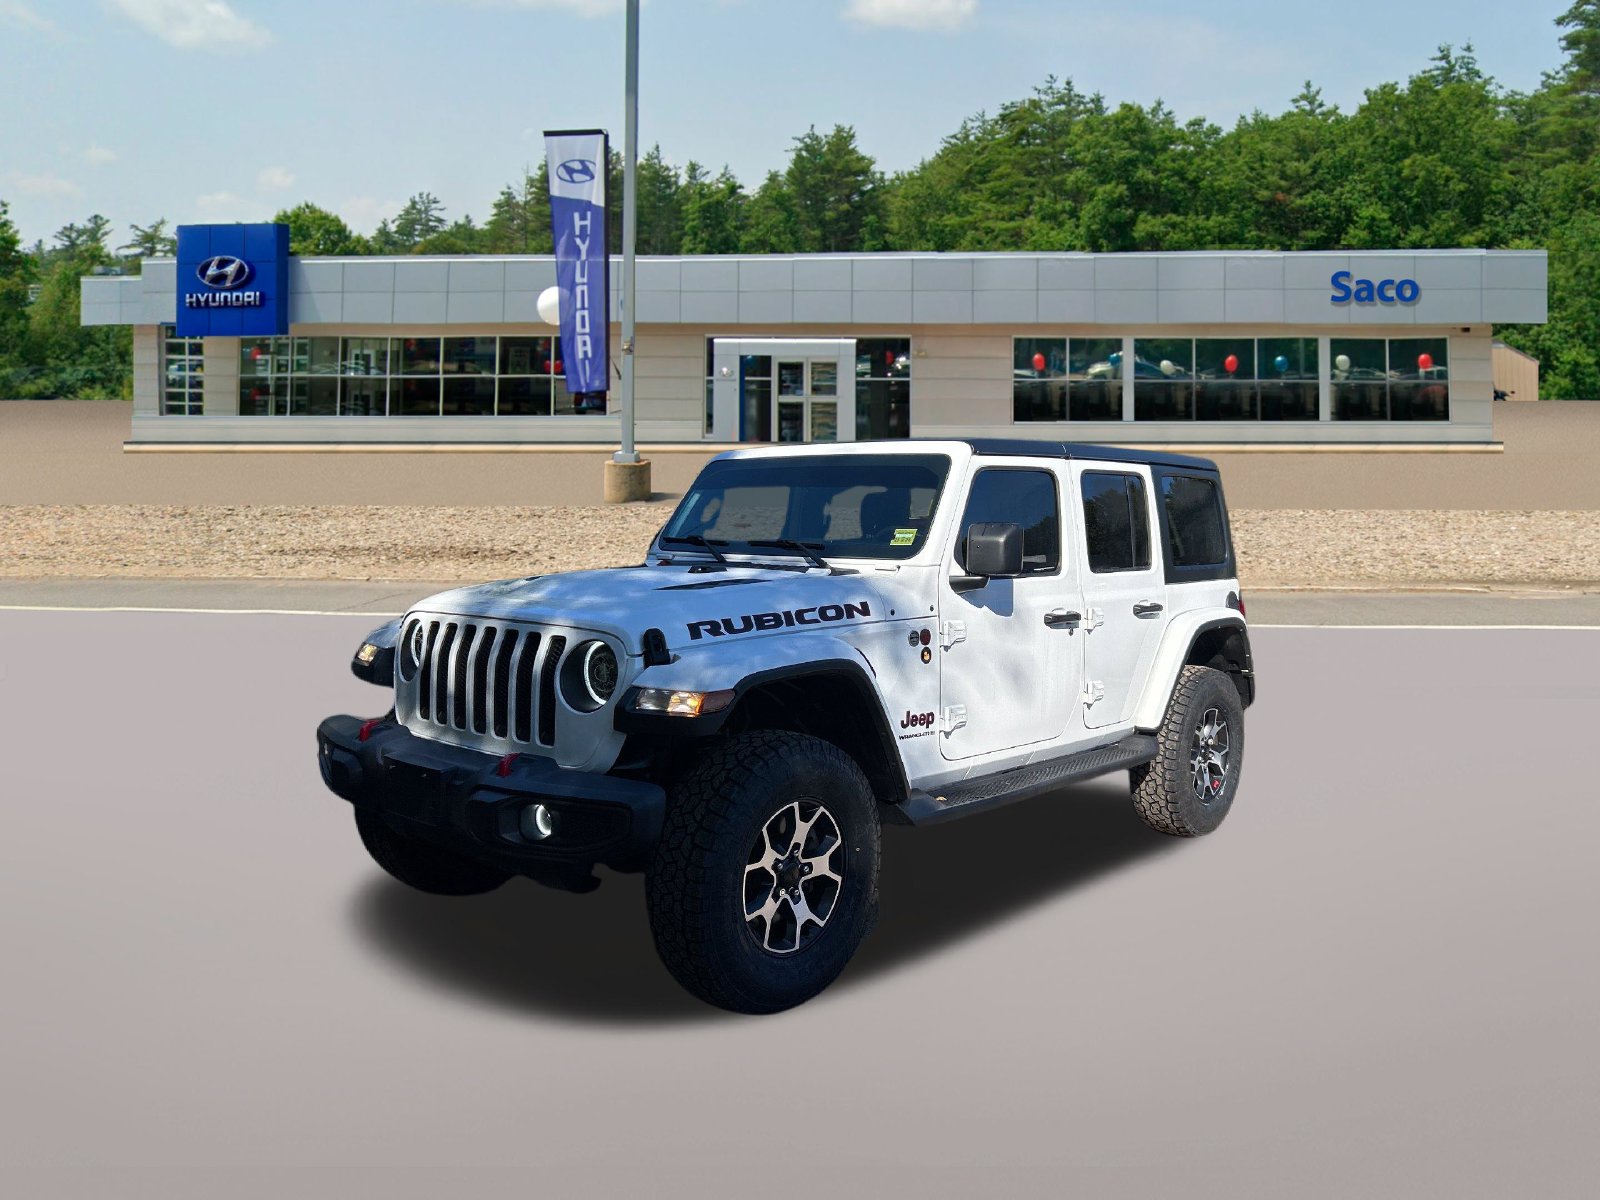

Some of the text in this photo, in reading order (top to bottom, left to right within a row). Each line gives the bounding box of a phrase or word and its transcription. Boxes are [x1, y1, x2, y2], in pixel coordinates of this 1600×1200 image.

[185, 291, 261, 307] HYUNDAI
[573, 211, 592, 384] HYUNDAI
[1330, 270, 1420, 303] Saco
[686, 601, 871, 640] RUBICON
[900, 710, 935, 729] Jeep
